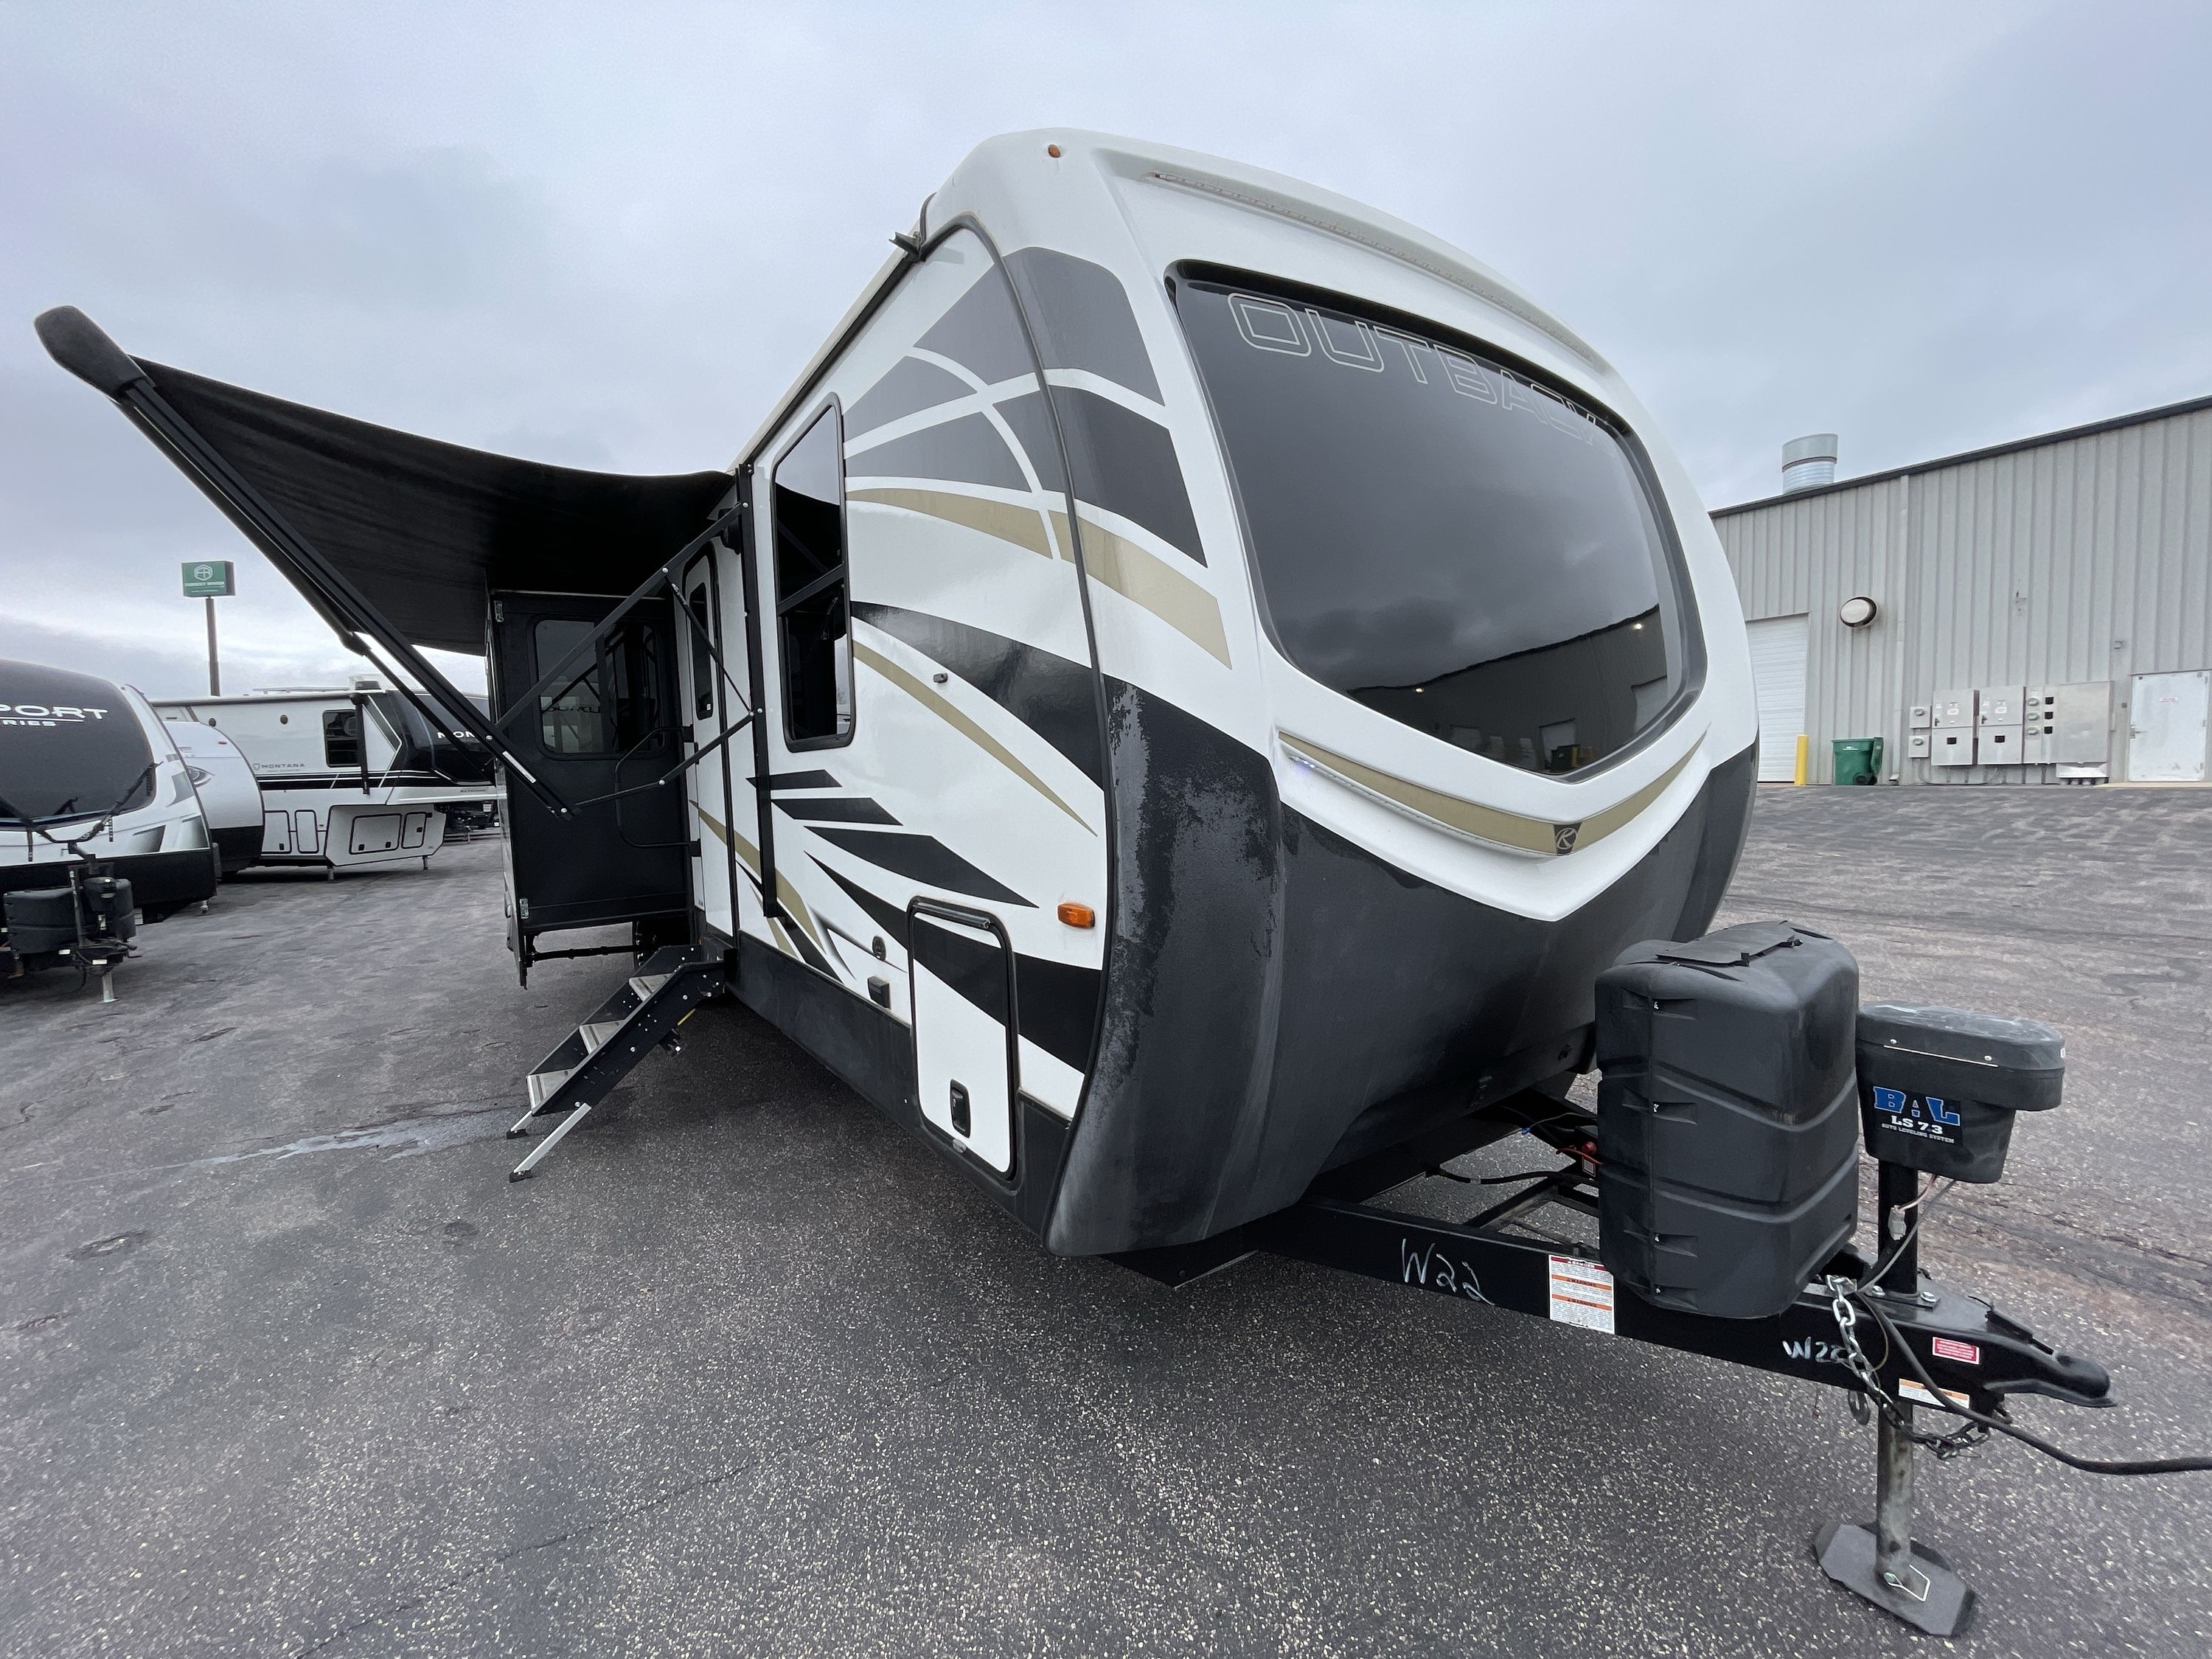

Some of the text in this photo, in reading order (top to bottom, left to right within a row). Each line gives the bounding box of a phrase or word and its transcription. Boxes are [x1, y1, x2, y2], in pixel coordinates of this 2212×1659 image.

[1227, 292, 1613, 457] OUTBACK
[1874, 1086, 1961, 1126] BAL
[1891, 1115, 1943, 1135] LS 73
[1898, 1126, 1928, 1138] LEVELING
[1929, 1133, 1955, 1144] SYSTEM
[1402, 1237, 1495, 1306] W22
[1571, 1278, 1596, 1287] WARNING
